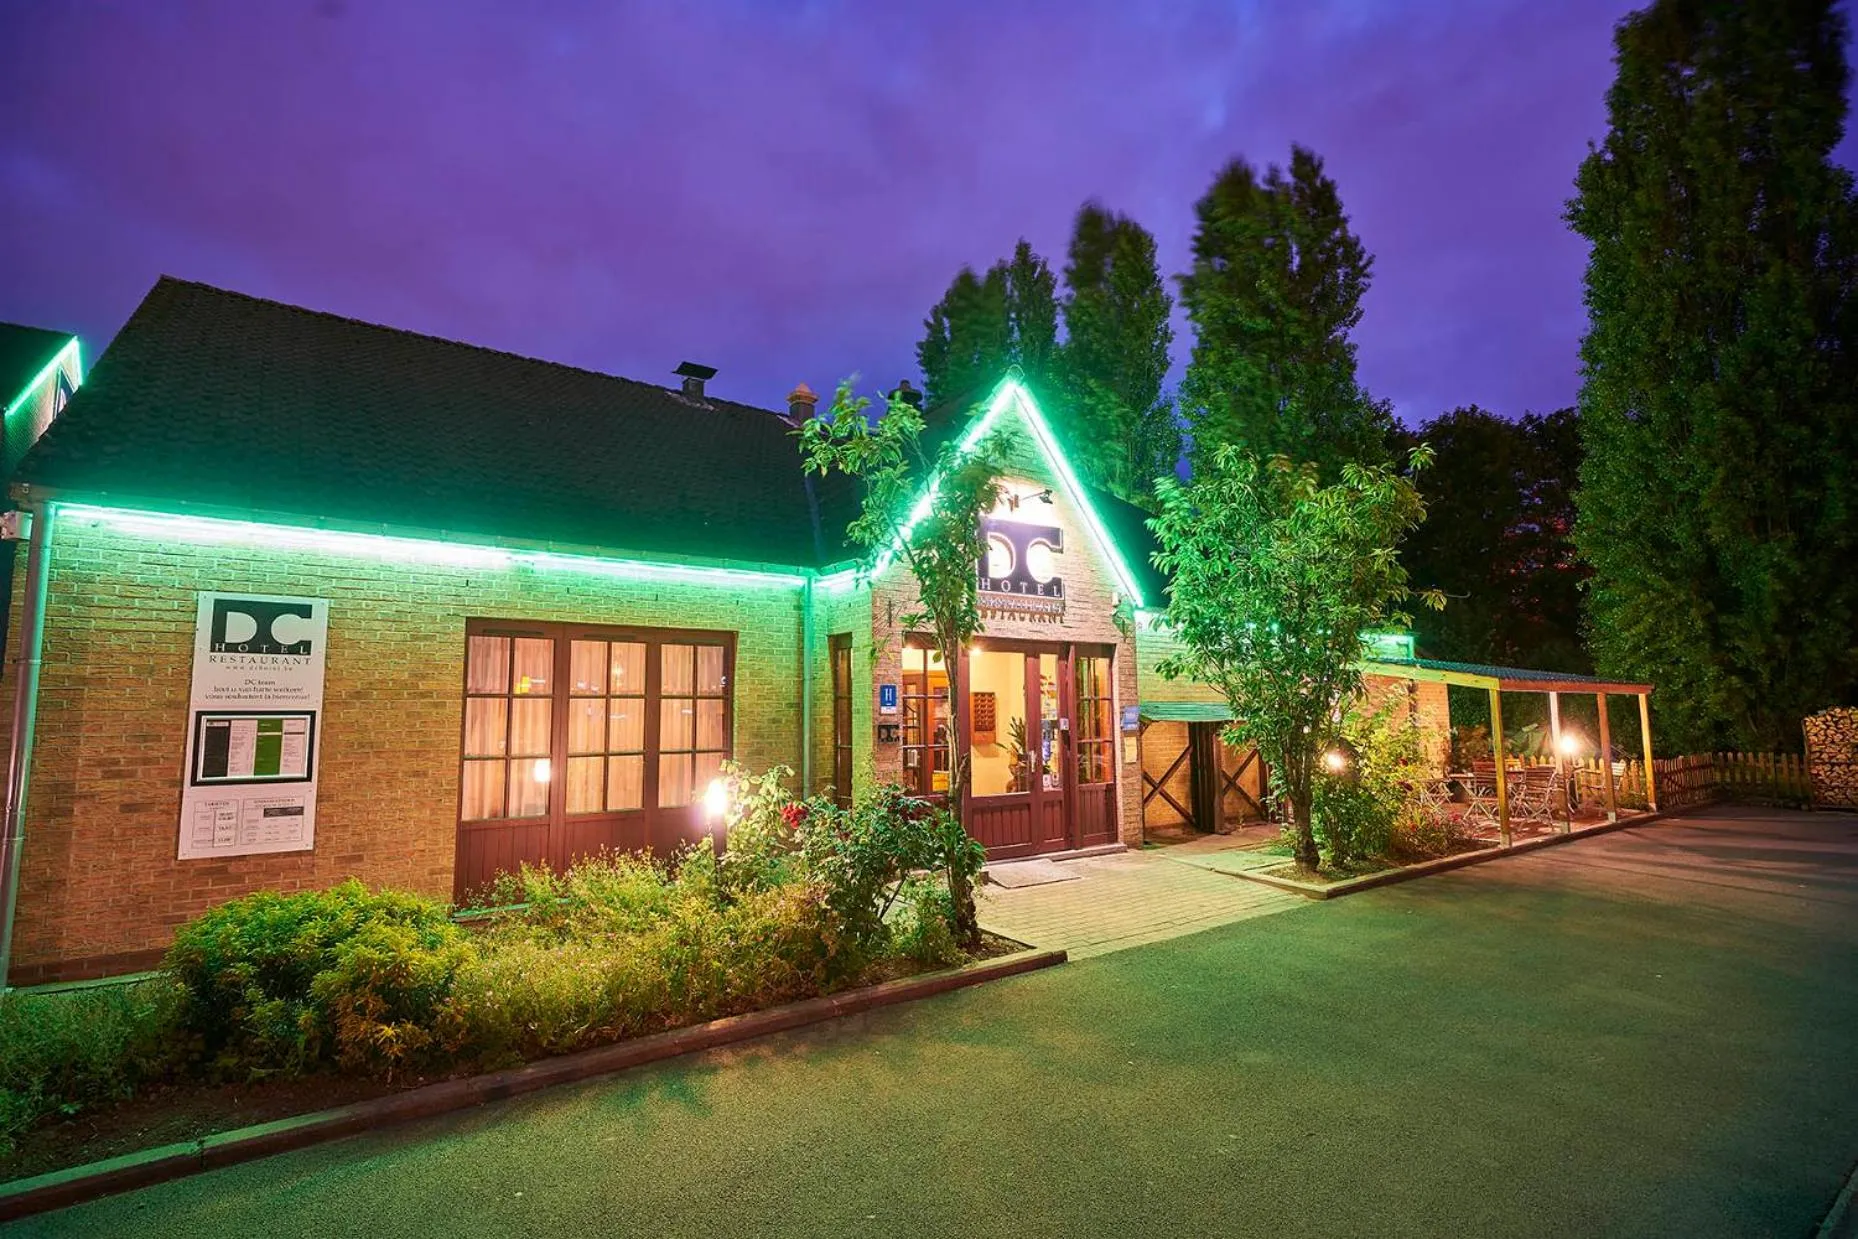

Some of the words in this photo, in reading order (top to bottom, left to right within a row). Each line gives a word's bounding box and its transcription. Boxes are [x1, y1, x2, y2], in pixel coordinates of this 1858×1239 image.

[977, 518, 1063, 598] DC
[981, 578, 1061, 597] HOTEL
[210, 599, 313, 655] DC
[215, 643, 308, 655] HOTEL
[209, 655, 312, 665] RESTAURANT
[884, 688, 893, 701] H
